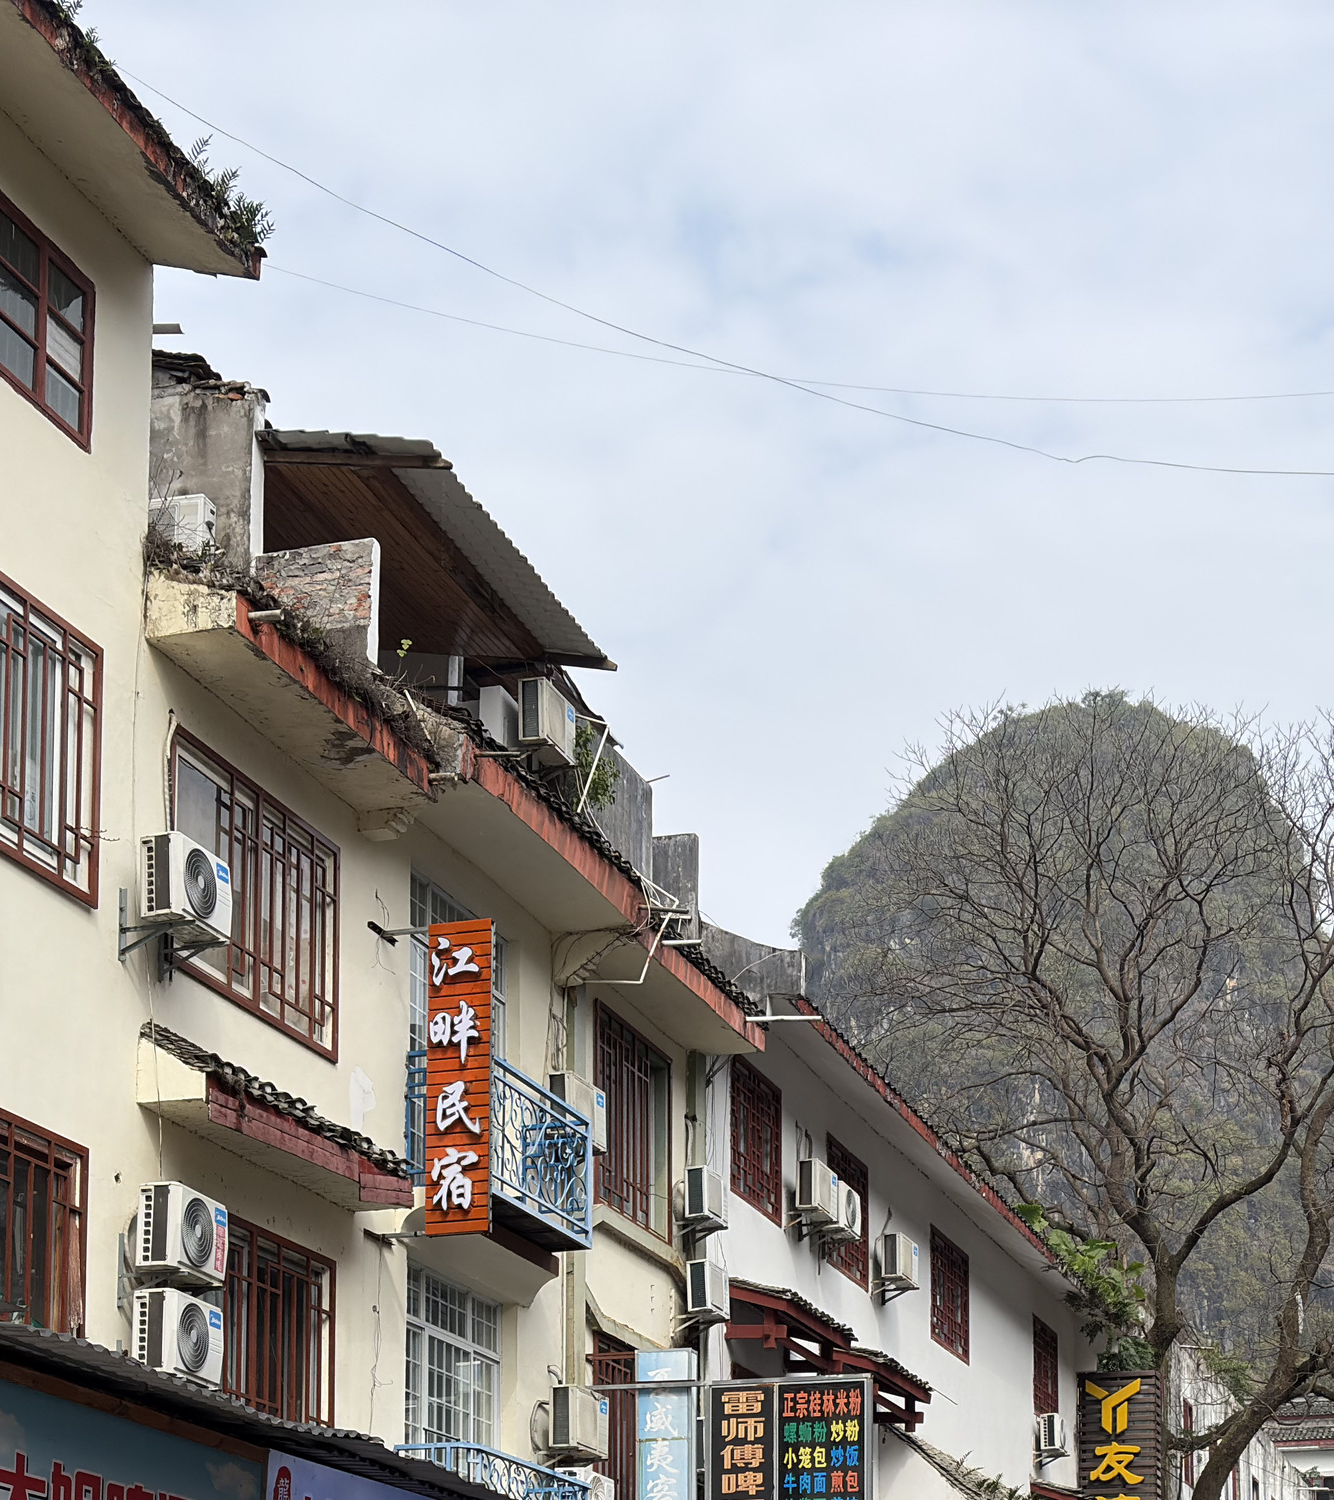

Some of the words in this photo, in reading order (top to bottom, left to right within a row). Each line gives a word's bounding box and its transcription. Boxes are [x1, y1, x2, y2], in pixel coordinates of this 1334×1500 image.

[429, 938, 481, 1213] 江畔民宿
[782, 1388, 862, 1418] 正宗桂林米粉
[783, 1421, 827, 1444] 螺蛳粉
[830, 1418, 859, 1442] 炒粉
[783, 1446, 827, 1469] 小笼包
[830, 1444, 859, 1467] 炒饭
[783, 1472, 827, 1495] 牛肉面
[830, 1470, 859, 1493] 煎包
